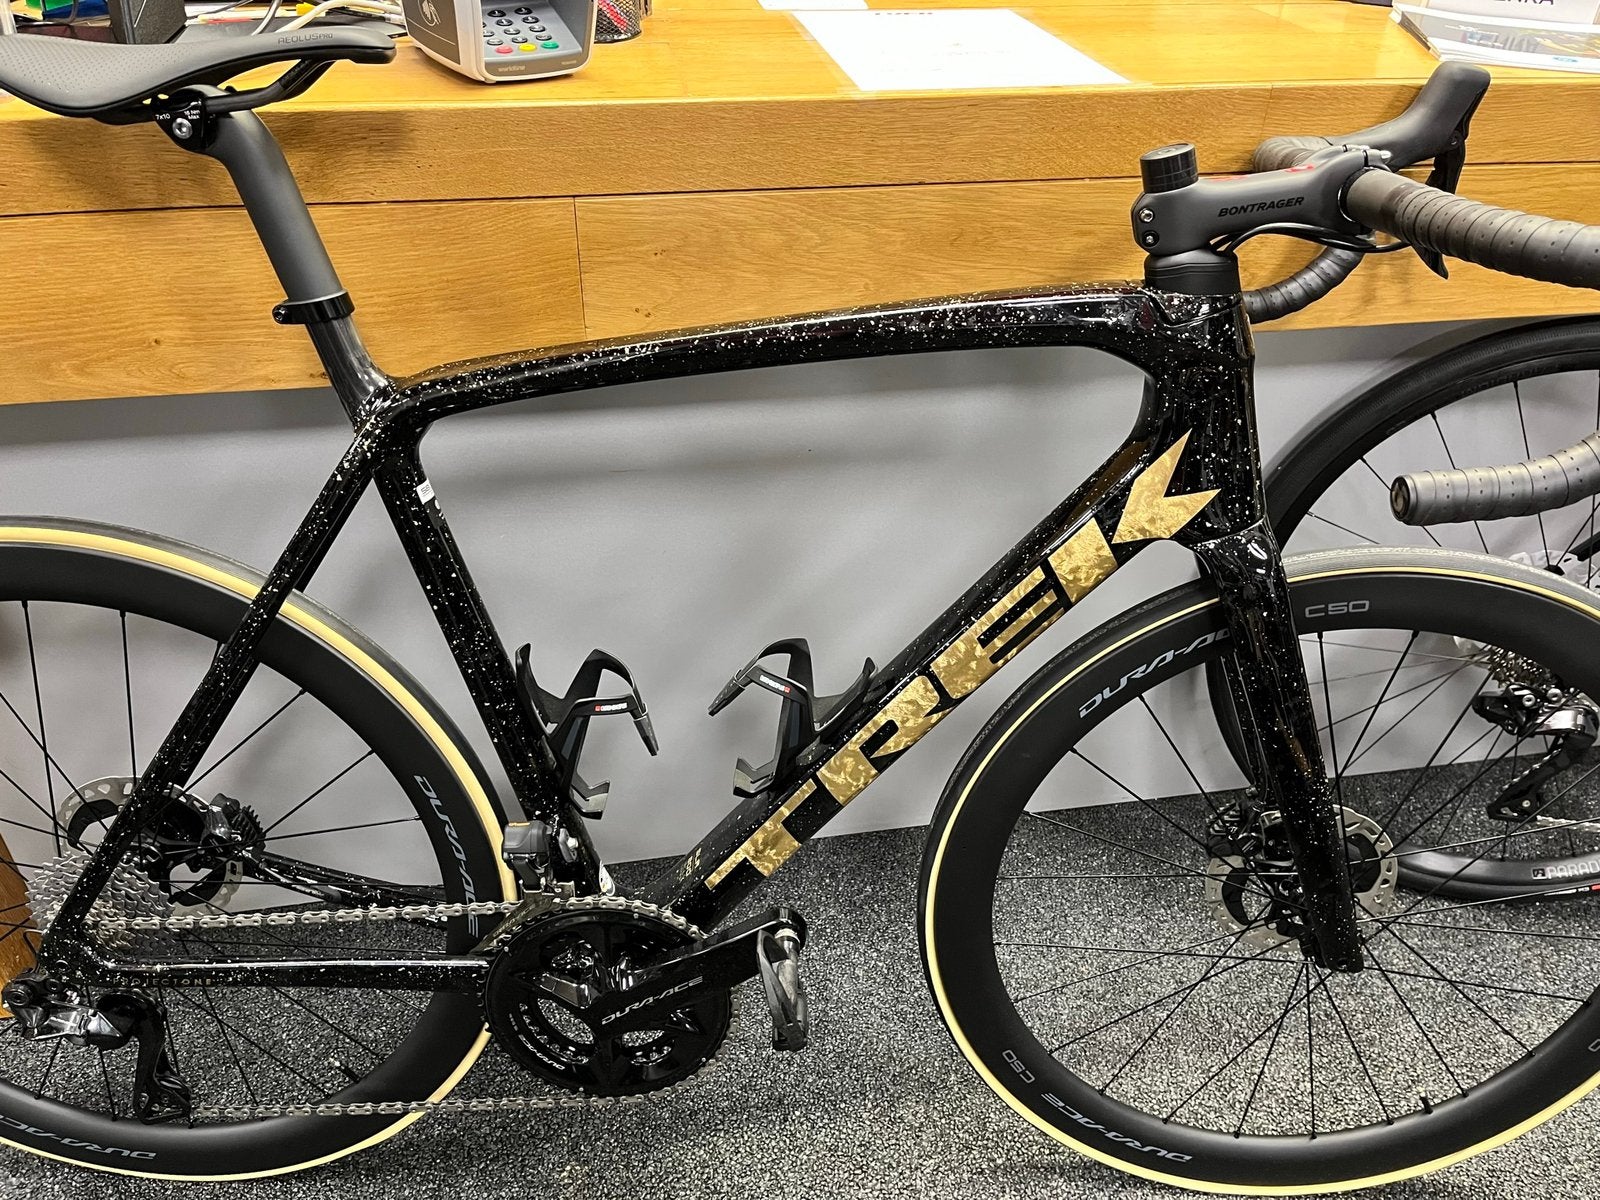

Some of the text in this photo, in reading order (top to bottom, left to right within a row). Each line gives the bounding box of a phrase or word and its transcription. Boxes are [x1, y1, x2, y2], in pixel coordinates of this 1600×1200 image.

[1218, 196, 1305, 218] BONTRAGER
[1305, 600, 1370, 618] C50
[704, 428, 1222, 890] TREK
[1079, 627, 1232, 719] DURA-AC
[601, 975, 703, 1026] DURA-ACE
[0, 1114, 157, 1160] DURA-AC
[1040, 1092, 1193, 1163] DURA-ACE
